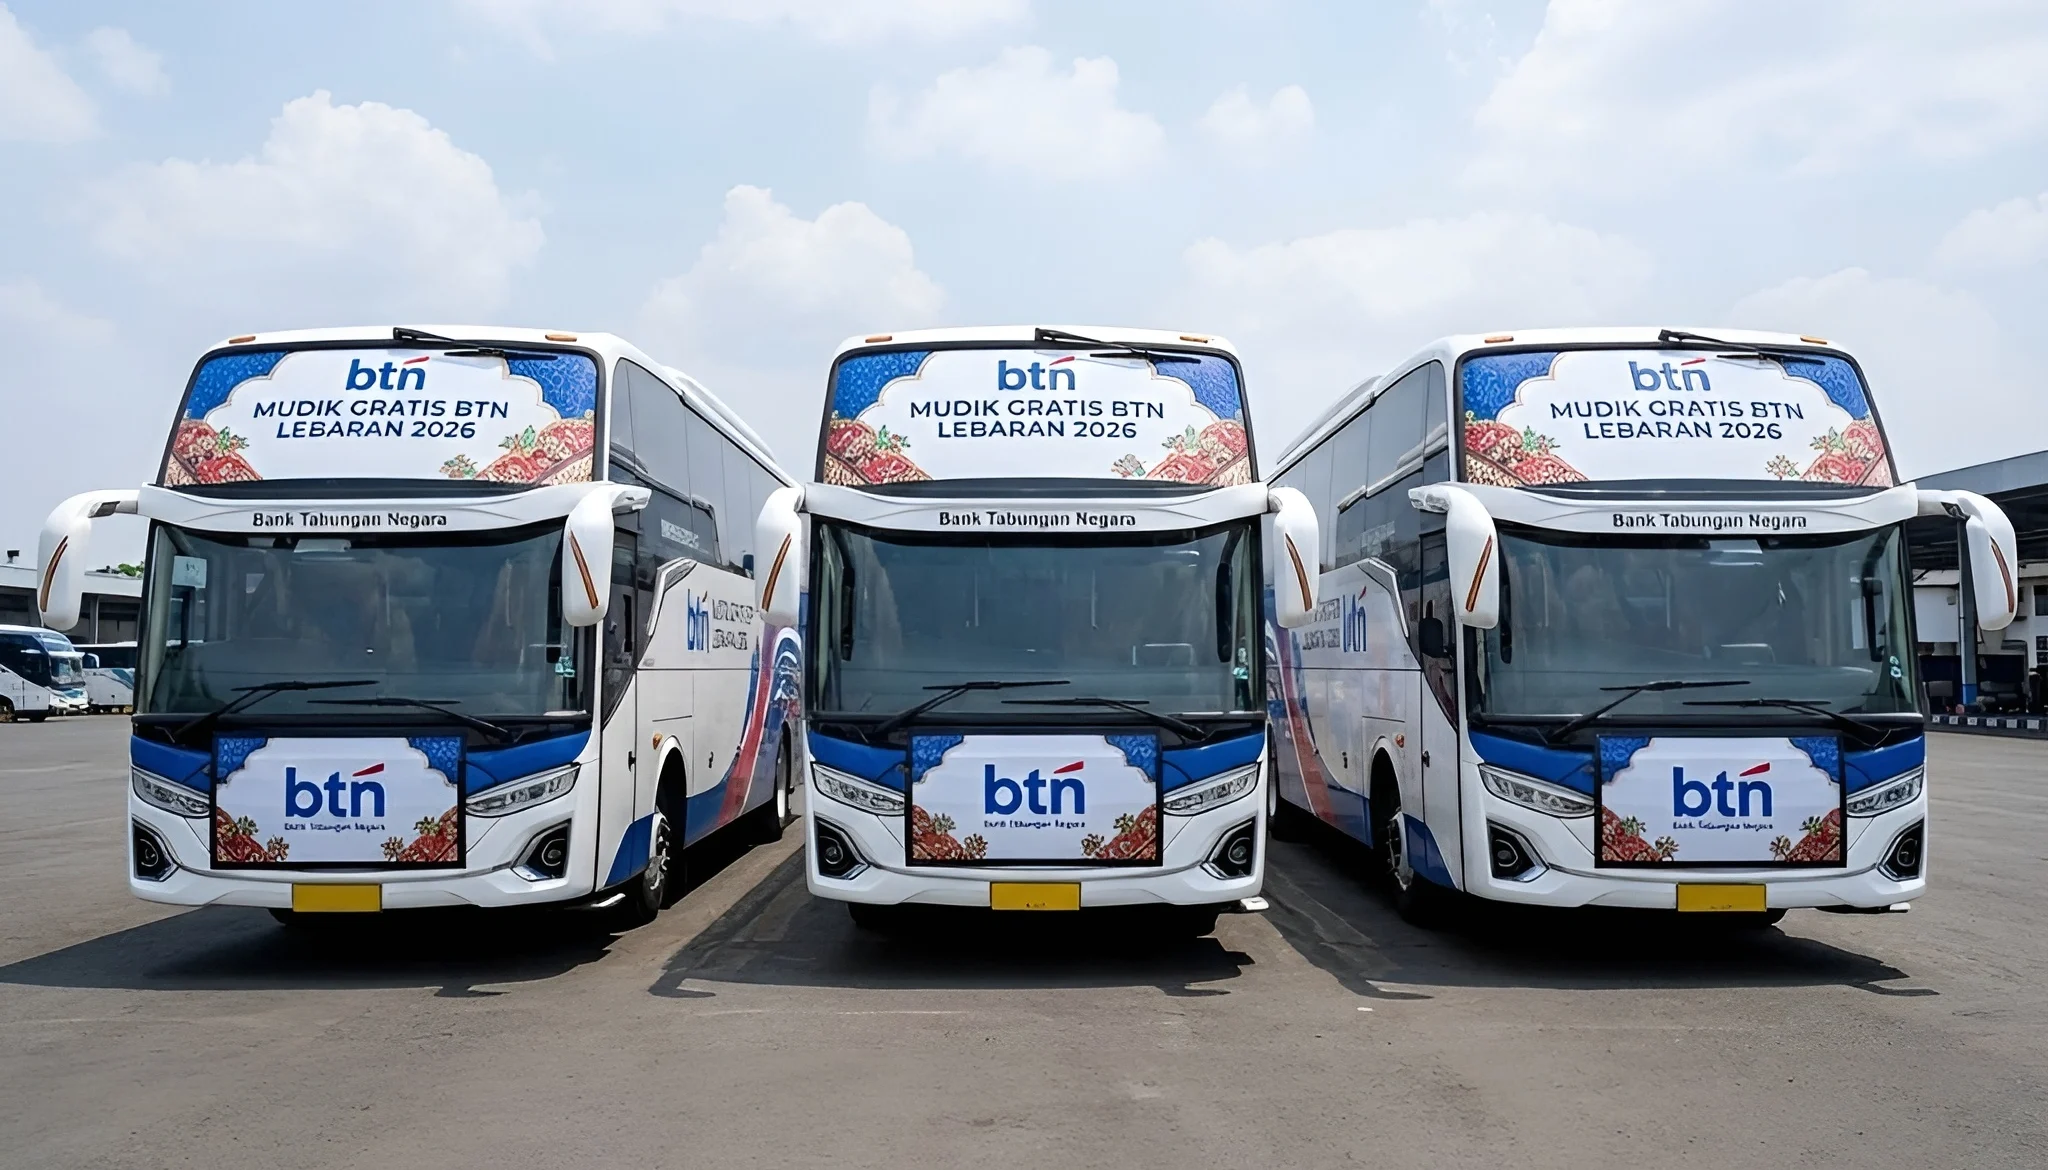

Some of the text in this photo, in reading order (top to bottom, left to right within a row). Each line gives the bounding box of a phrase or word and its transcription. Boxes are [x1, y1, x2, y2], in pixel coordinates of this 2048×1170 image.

[345, 356, 429, 391] btn
[998, 356, 1076, 391] btn
[1628, 358, 1711, 391] btn
[253, 400, 509, 418] MUDIK GRATIS BTN
[910, 400, 1164, 418] MUDIK GRATIS BTN
[1550, 400, 1804, 420] MUDIK GRATIS BTN
[276, 421, 476, 438] LEBARAN 2026
[938, 421, 1137, 438] LEBARAN 2026
[1584, 422, 1783, 439] LEBARAN 2026
[252, 512, 447, 528] Bank Tabungan Negara
[939, 511, 1136, 528] Bank Tabungan Negara
[1612, 513, 1807, 530] Bank Tabungan Negara
[286, 763, 385, 818] btn
[984, 760, 1085, 815] btn
[1673, 762, 1773, 818] btn
